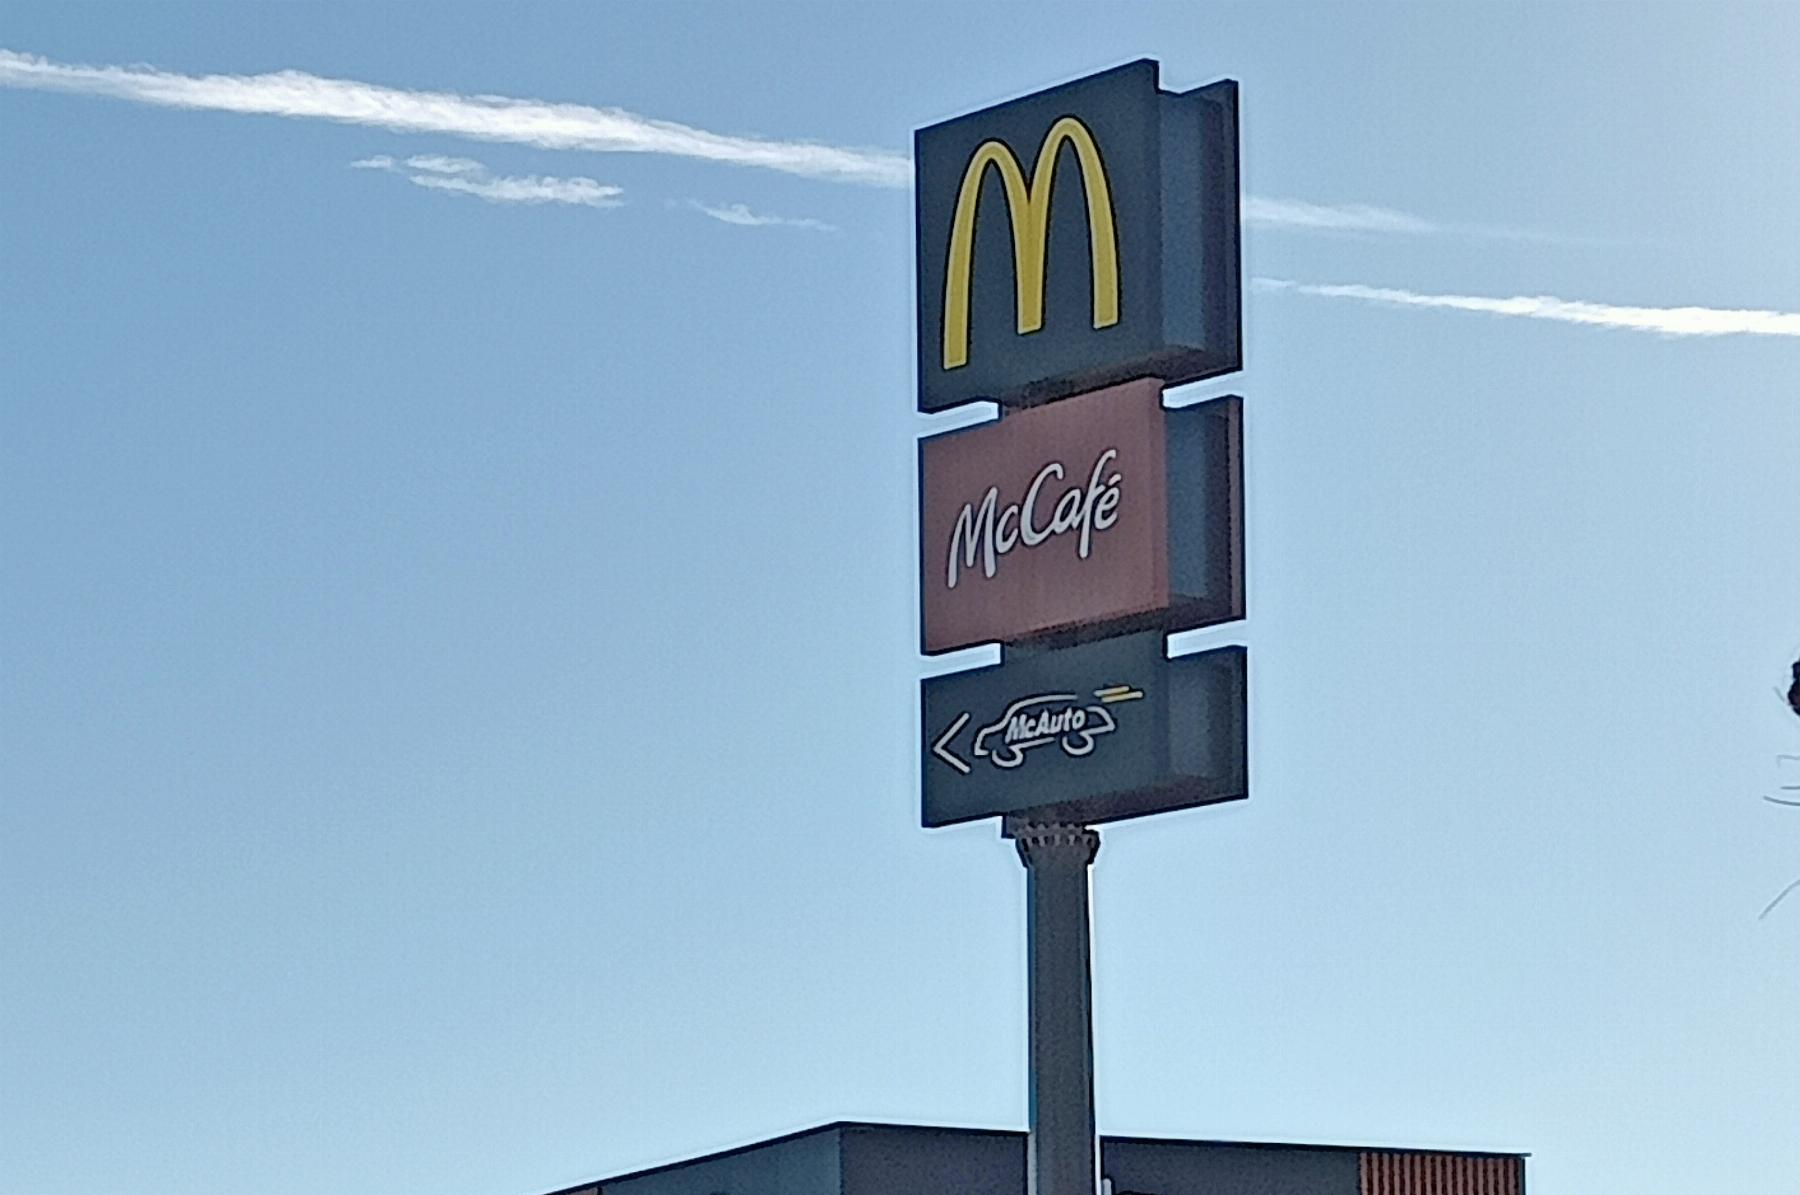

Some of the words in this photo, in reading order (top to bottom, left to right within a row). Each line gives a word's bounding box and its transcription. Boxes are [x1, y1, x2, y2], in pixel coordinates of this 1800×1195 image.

[943, 116, 1119, 370] M
[948, 449, 1122, 588] McCafé
[1005, 707, 1086, 744] McAuto
